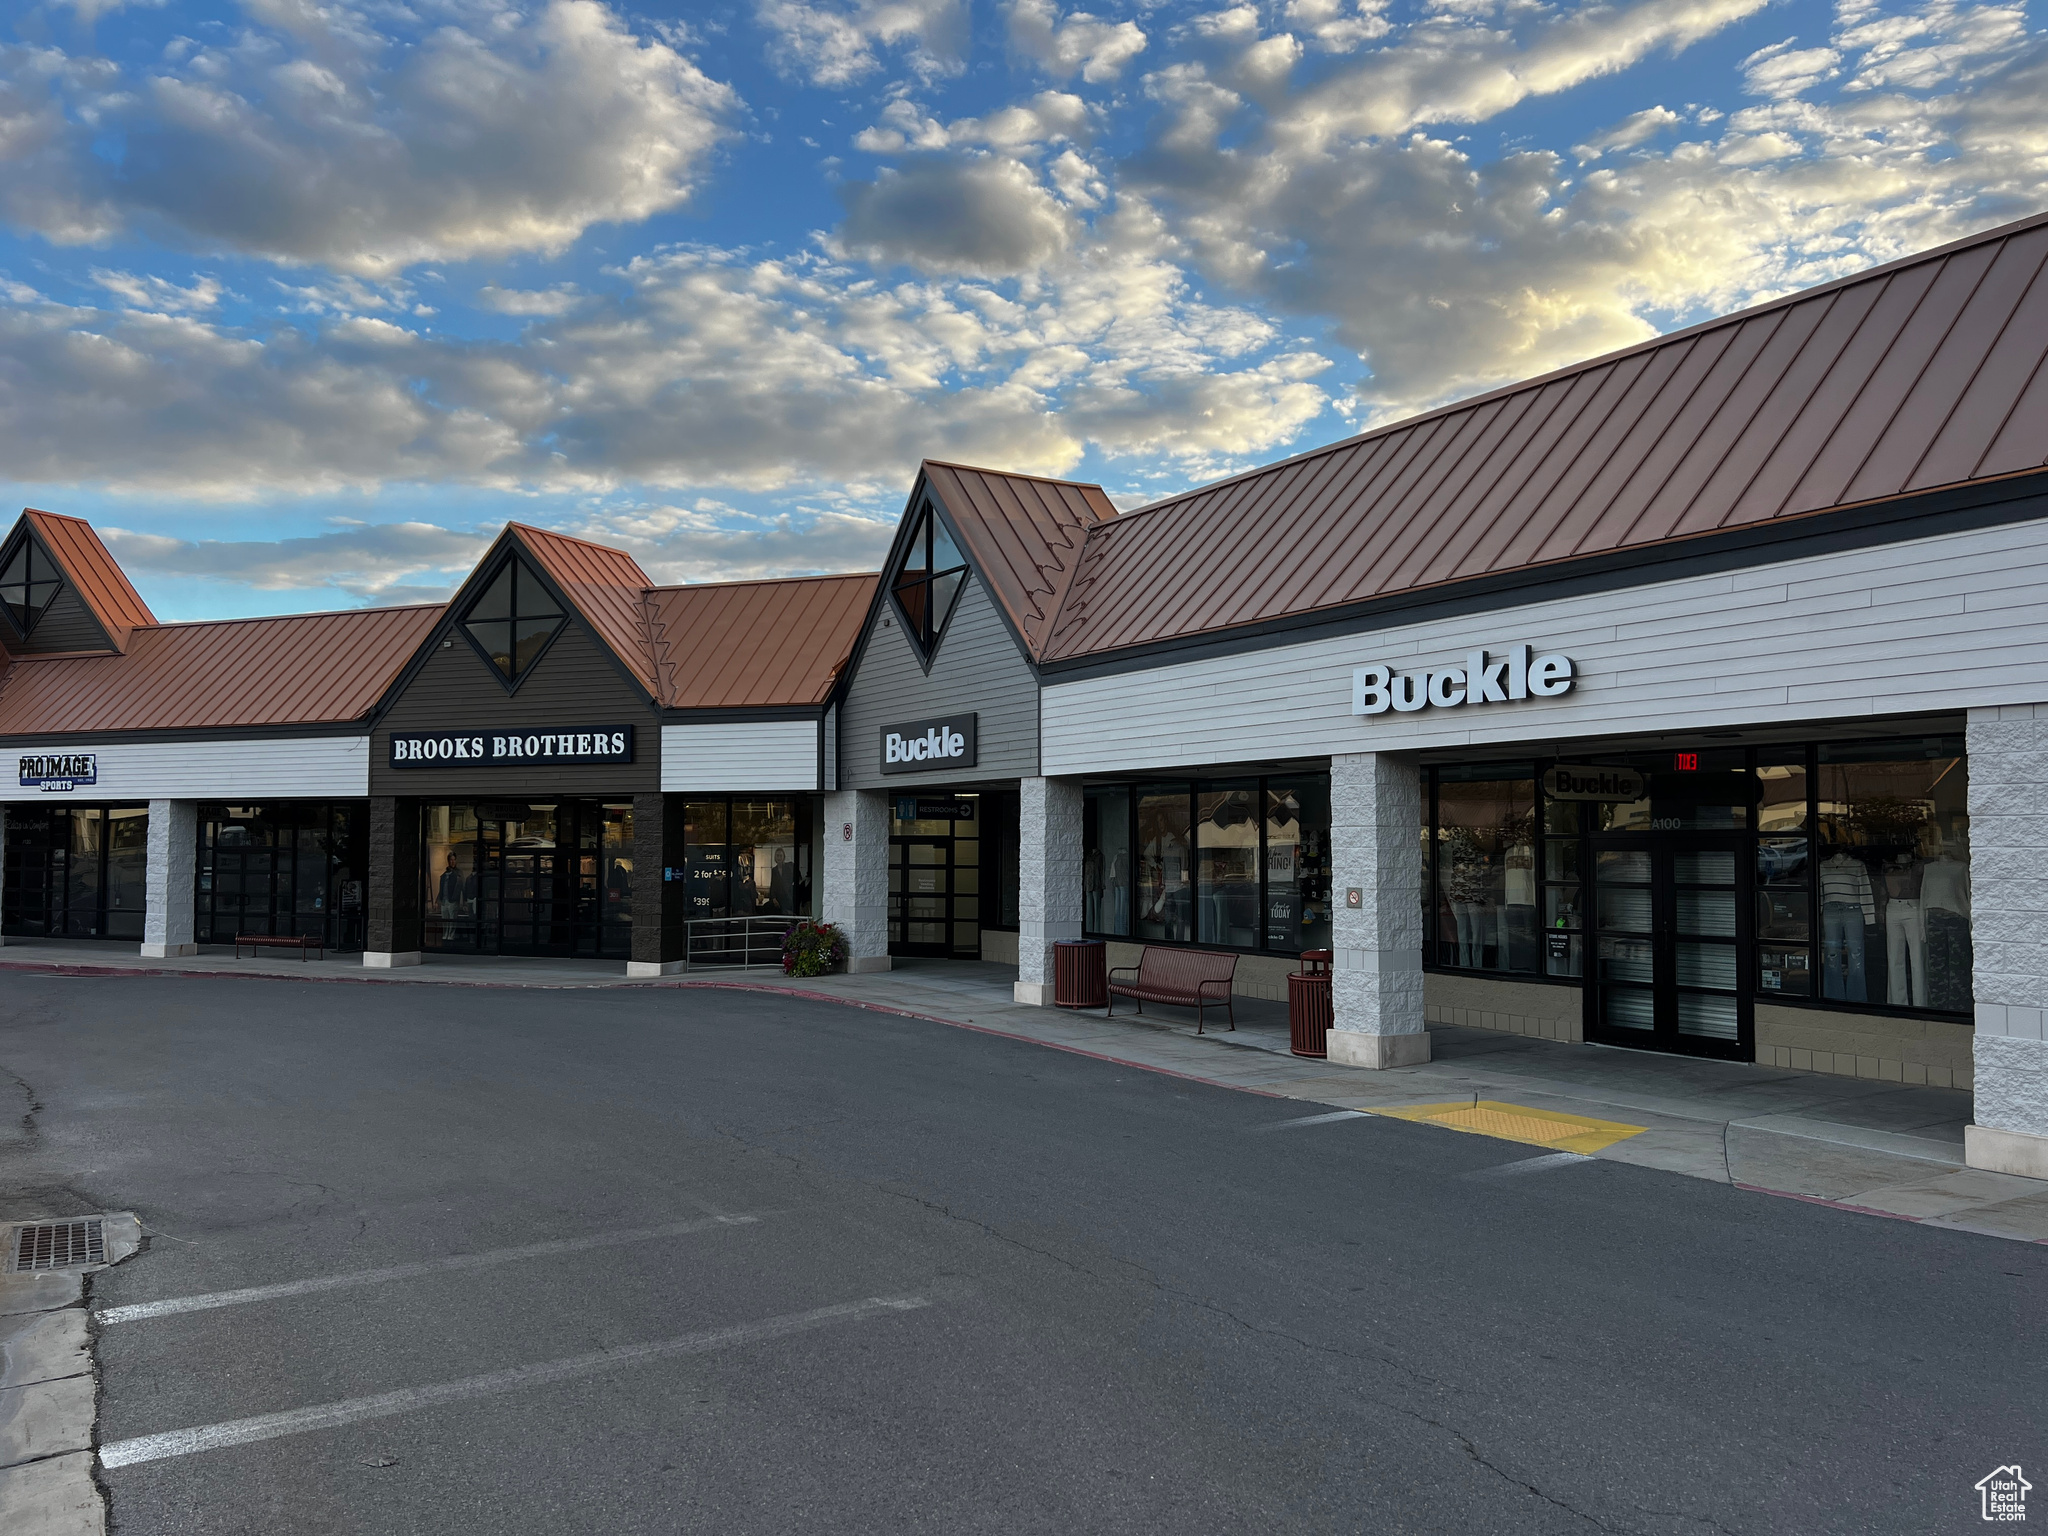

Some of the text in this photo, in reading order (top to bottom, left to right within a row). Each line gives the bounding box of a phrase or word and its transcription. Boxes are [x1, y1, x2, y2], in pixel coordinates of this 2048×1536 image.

[1352, 645, 1577, 716] Buckle
[394, 732, 625, 760] BROOKS BROTHERS
[885, 725, 965, 764] Buckle
[19, 756, 90, 778] PRO IMAGE
[40, 780, 73, 790] SPORTS
[1555, 771, 1632, 795] Buckle
[919, 806, 958, 814] RESTROOMS
[1652, 817, 1682, 830] A100
[693, 870, 700, 879] 2
[701, 870, 713, 879] for
[1270, 908, 1291, 919] TODAY
